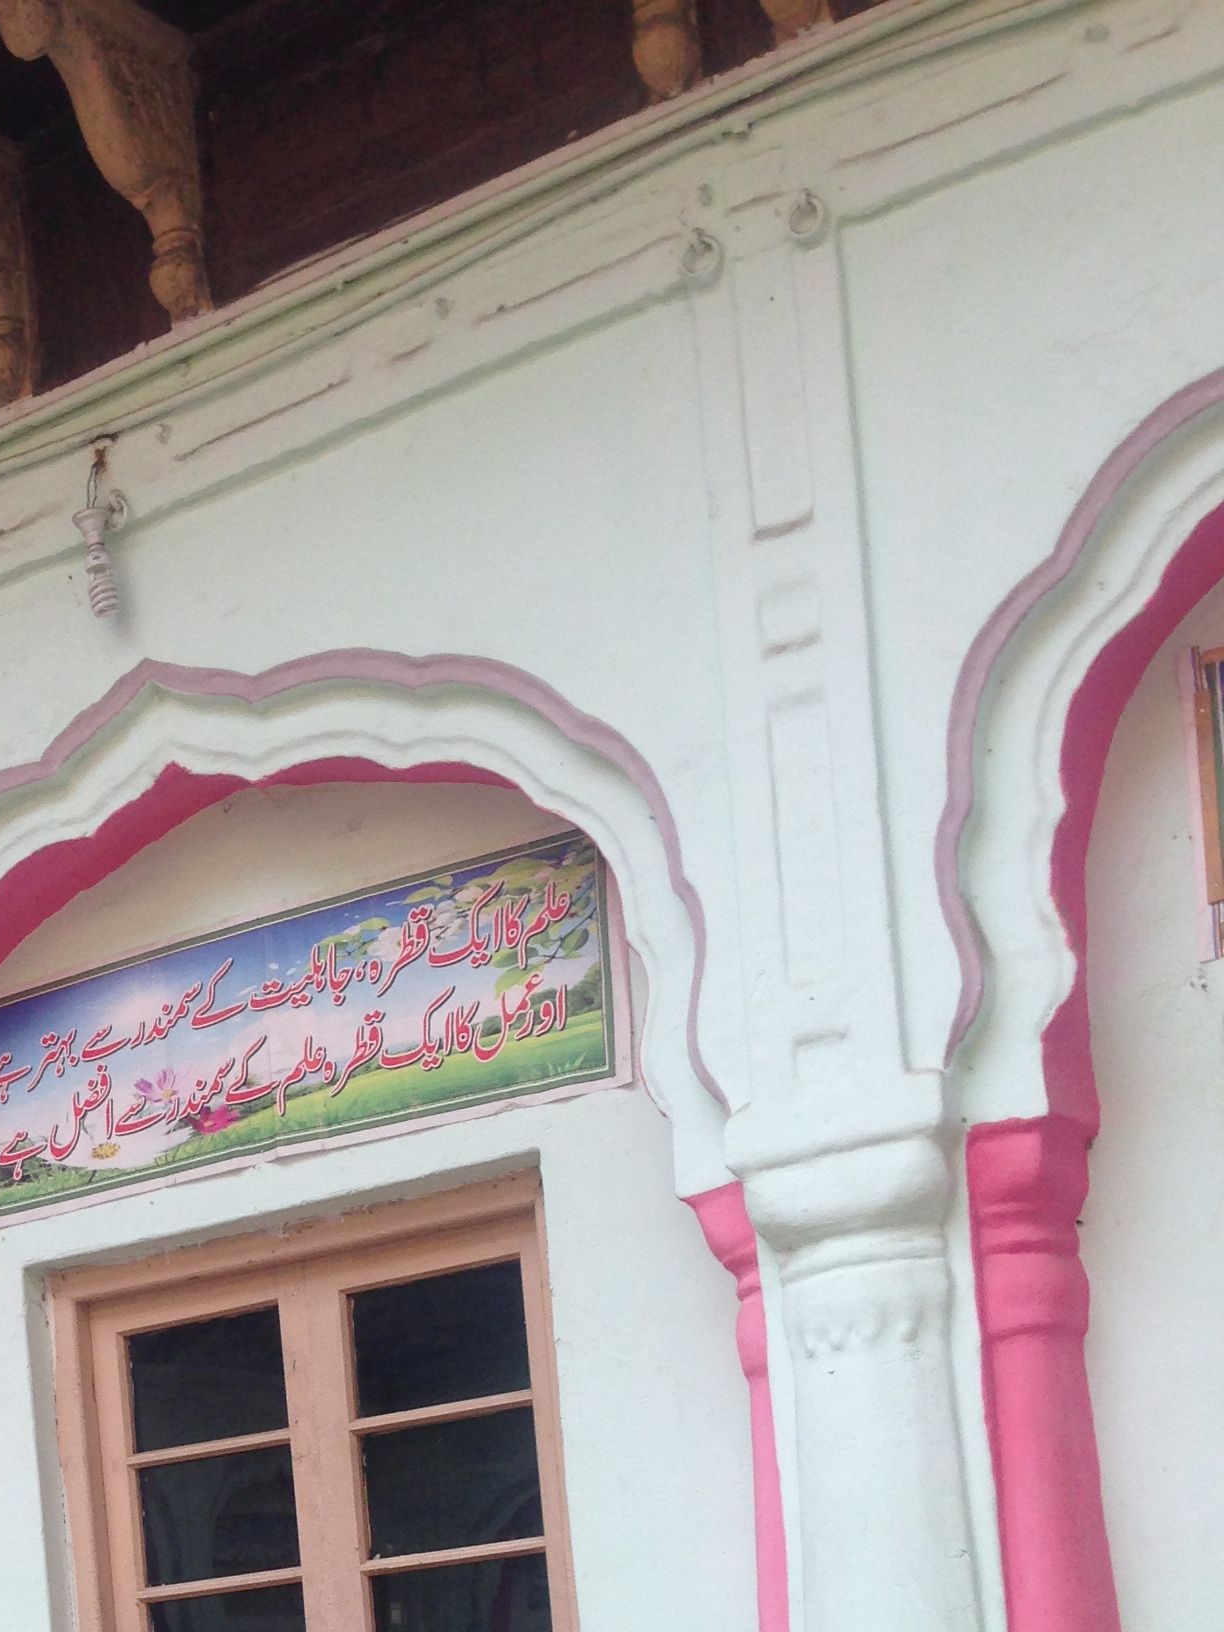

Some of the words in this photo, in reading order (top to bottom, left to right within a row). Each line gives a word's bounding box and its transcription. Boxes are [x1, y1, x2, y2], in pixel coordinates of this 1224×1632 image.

[428, 880, 506, 968] ایک
[503, 894, 530, 948] کا
[520, 881, 572, 968] علم
[191, 957, 245, 1029] کے
[249, 944, 352, 1011] جاہلیت
[515, 984, 566, 1040] اور
[81, 1024, 130, 1061] سے
[130, 981, 202, 1049] سمندر
[379, 985, 455, 1070] ایک
[454, 1001, 480, 1052] کا
[472, 973, 544, 1062] عمل
[27, 1028, 79, 1092] بہتر
[224, 1035, 277, 1105] کے
[276, 1034, 326, 1116] علم
[323, 1009, 386, 1096] قطرہ
[49, 1063, 113, 1161] افضل
[113, 1097, 166, 1136] سے
[165, 1058, 234, 1125] سمندر
